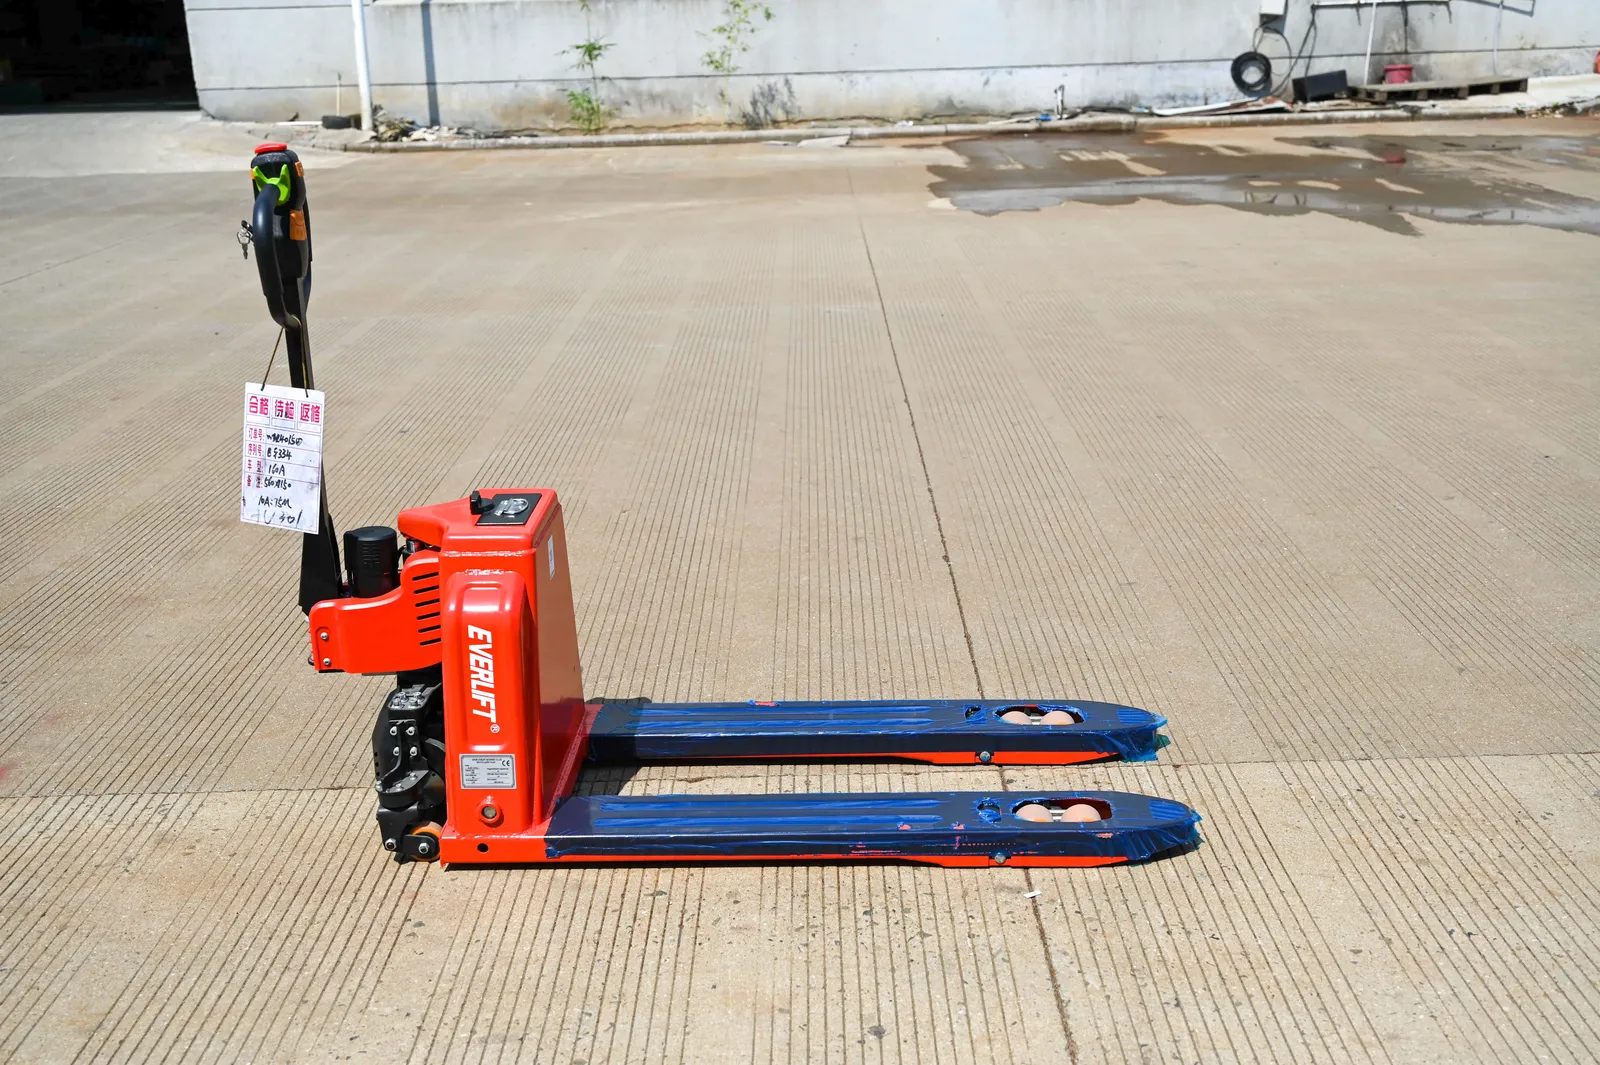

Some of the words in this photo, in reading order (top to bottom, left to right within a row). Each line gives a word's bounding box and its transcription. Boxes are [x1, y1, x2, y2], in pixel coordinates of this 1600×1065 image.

[249, 395, 269, 416] 合格
[274, 399, 295, 420] 待检
[300, 402, 321, 423] 返修
[467, 624, 497, 723] EVERLIFT
